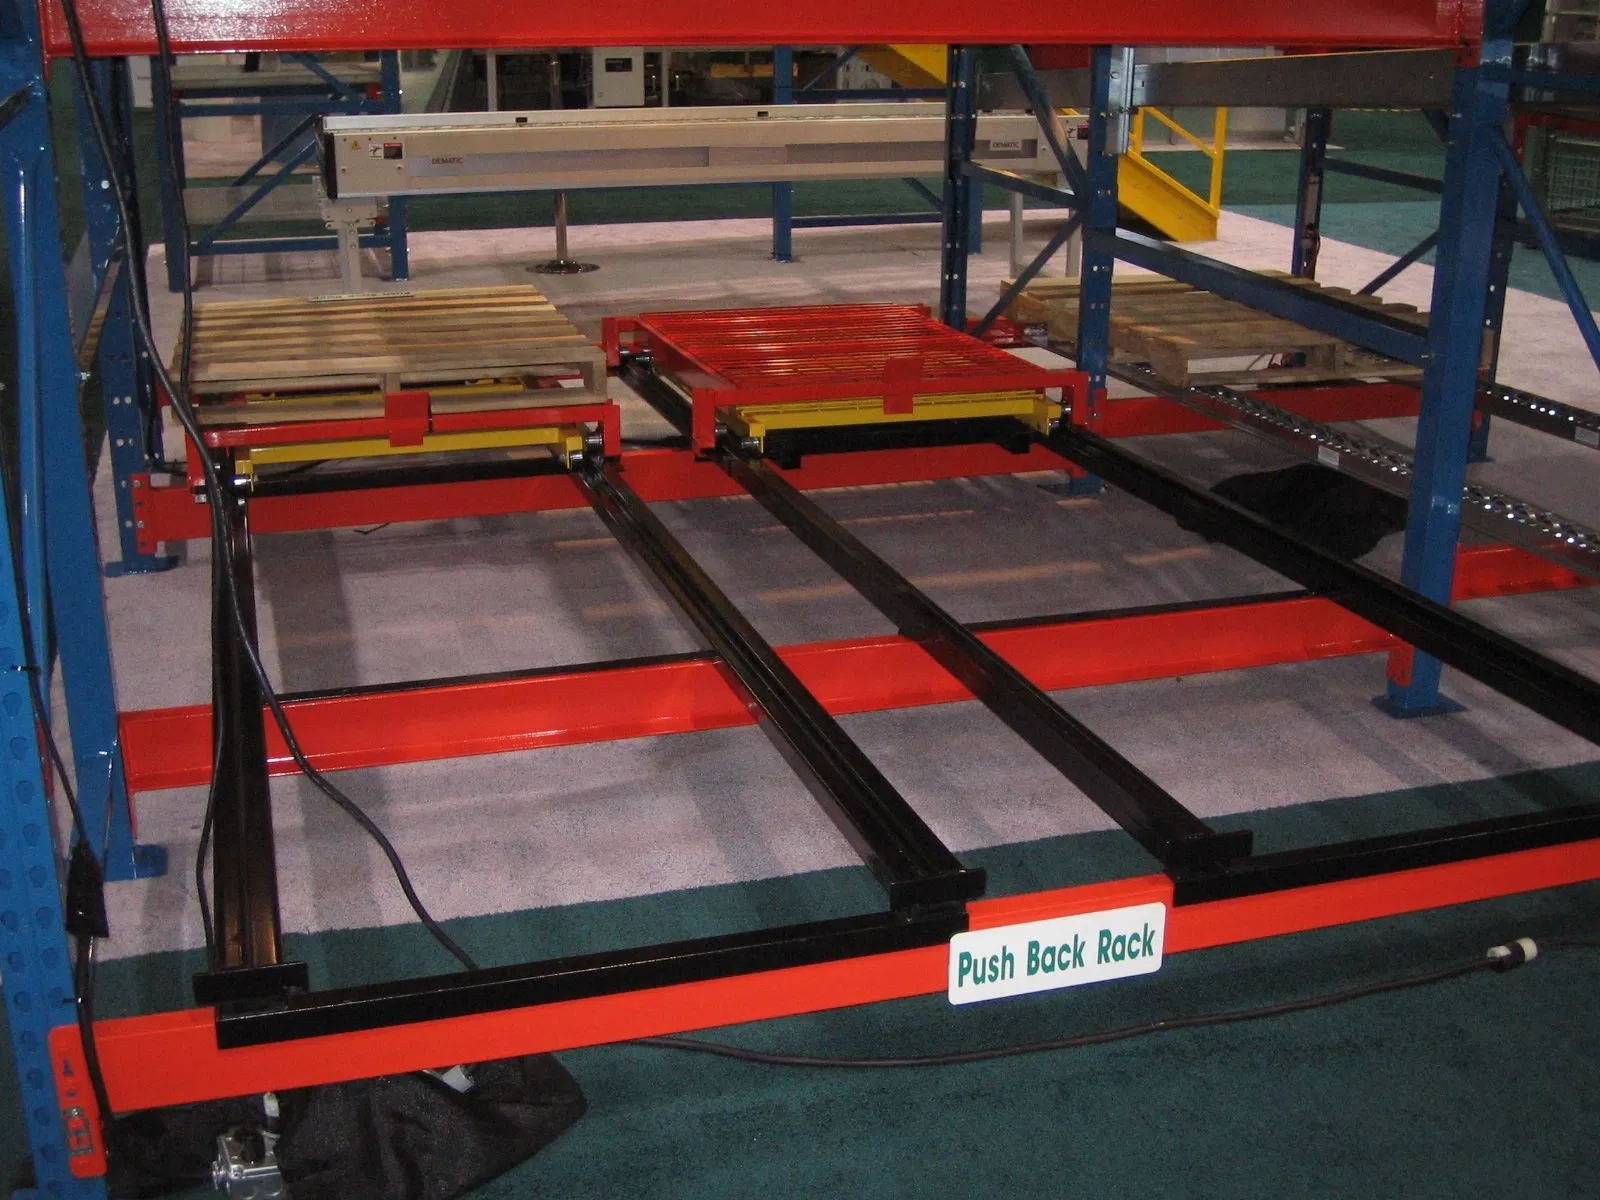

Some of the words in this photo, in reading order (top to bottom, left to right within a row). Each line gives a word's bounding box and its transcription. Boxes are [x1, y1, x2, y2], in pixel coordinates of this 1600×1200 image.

[958, 945, 1014, 987] Push
[1027, 933, 1087, 976] Back
[1097, 922, 1156, 964] Rack
